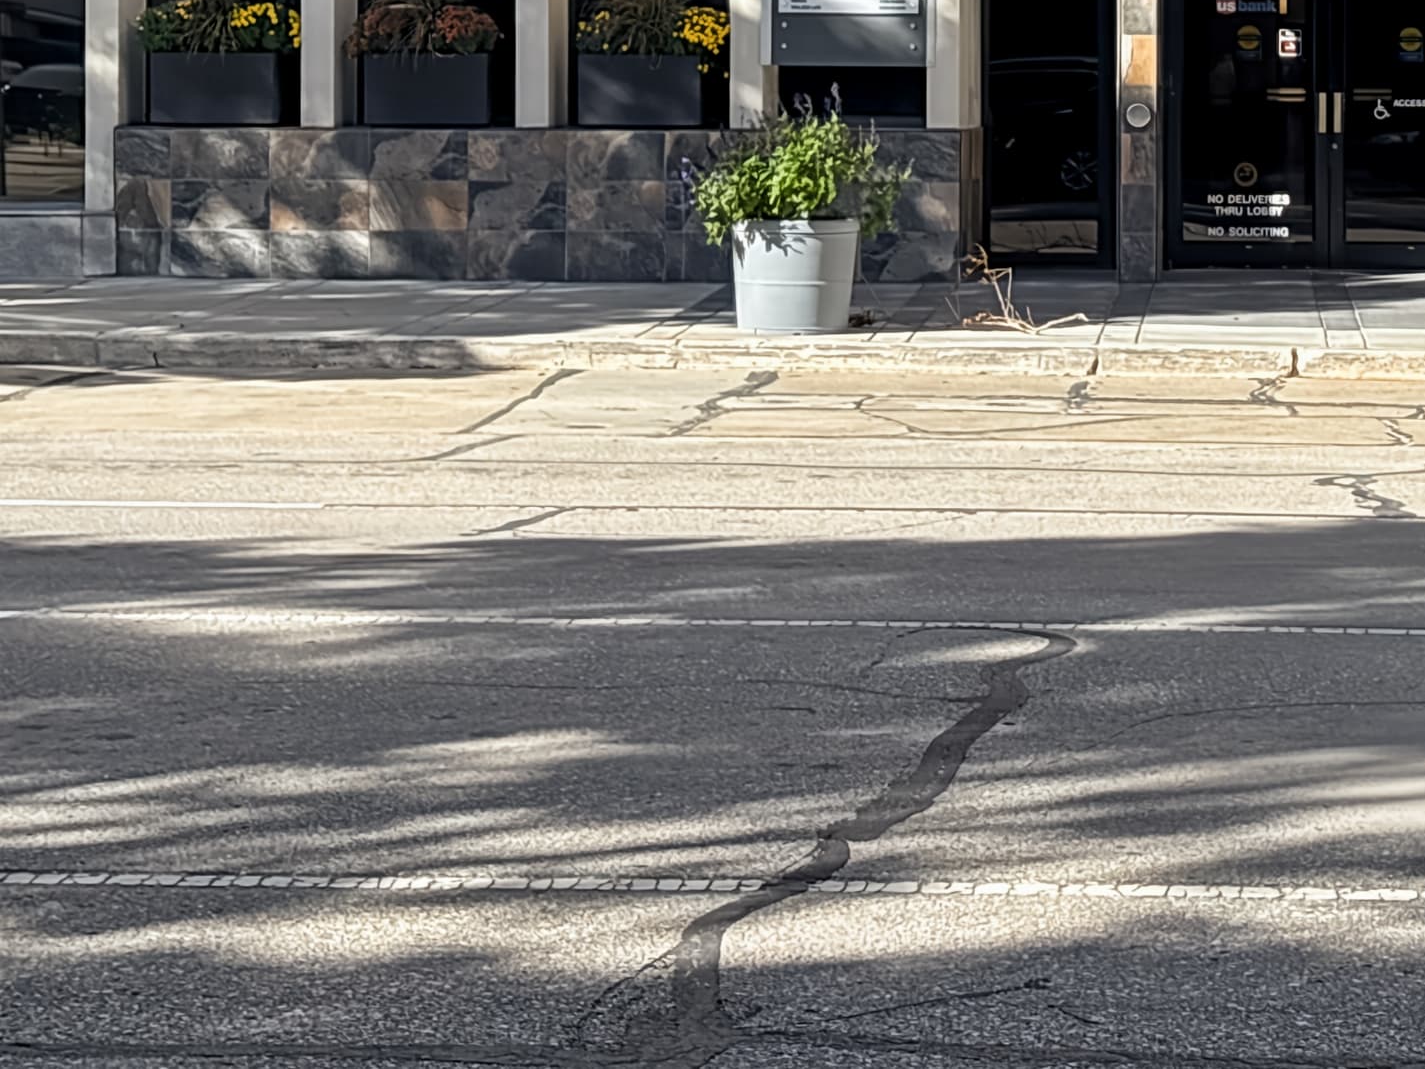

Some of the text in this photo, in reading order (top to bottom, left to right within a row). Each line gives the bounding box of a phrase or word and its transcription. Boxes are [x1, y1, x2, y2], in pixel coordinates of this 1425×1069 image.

[1207, 194, 1224, 204] NO
[1214, 206, 1284, 216] THRU LOBBY
[1208, 227, 1224, 236] NO
